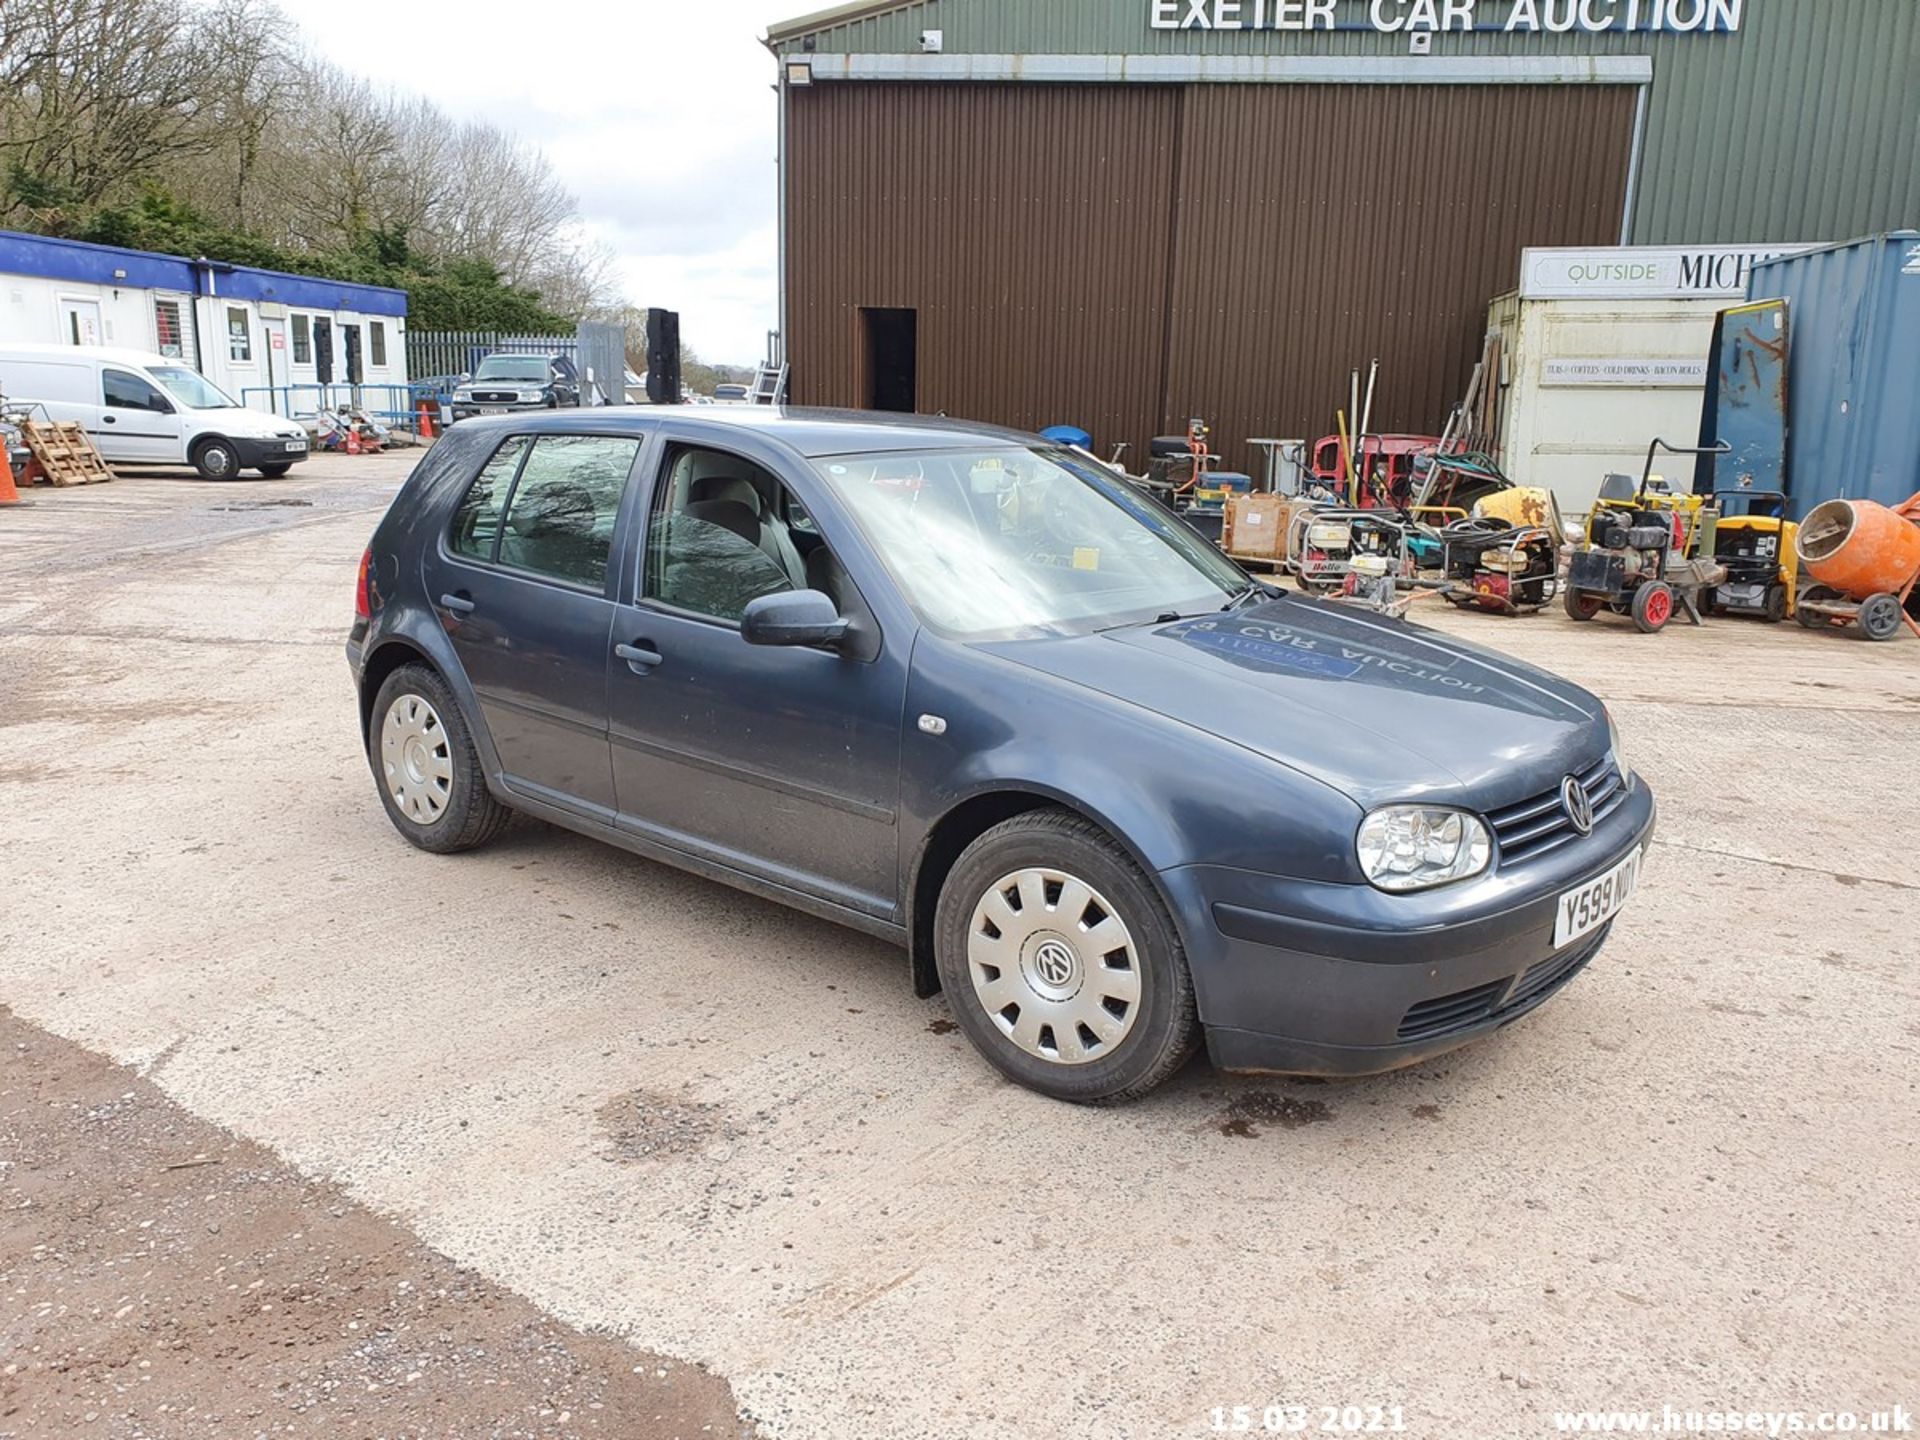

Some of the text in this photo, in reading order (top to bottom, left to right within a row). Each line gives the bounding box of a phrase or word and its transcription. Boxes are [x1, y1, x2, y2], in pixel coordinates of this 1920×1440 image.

[1369, 0, 1473, 32] CAR
[1567, 263, 1657, 281] OUTSIDE
[1677, 253, 1770, 290] MICH
[1566, 876, 1613, 936] Y599
